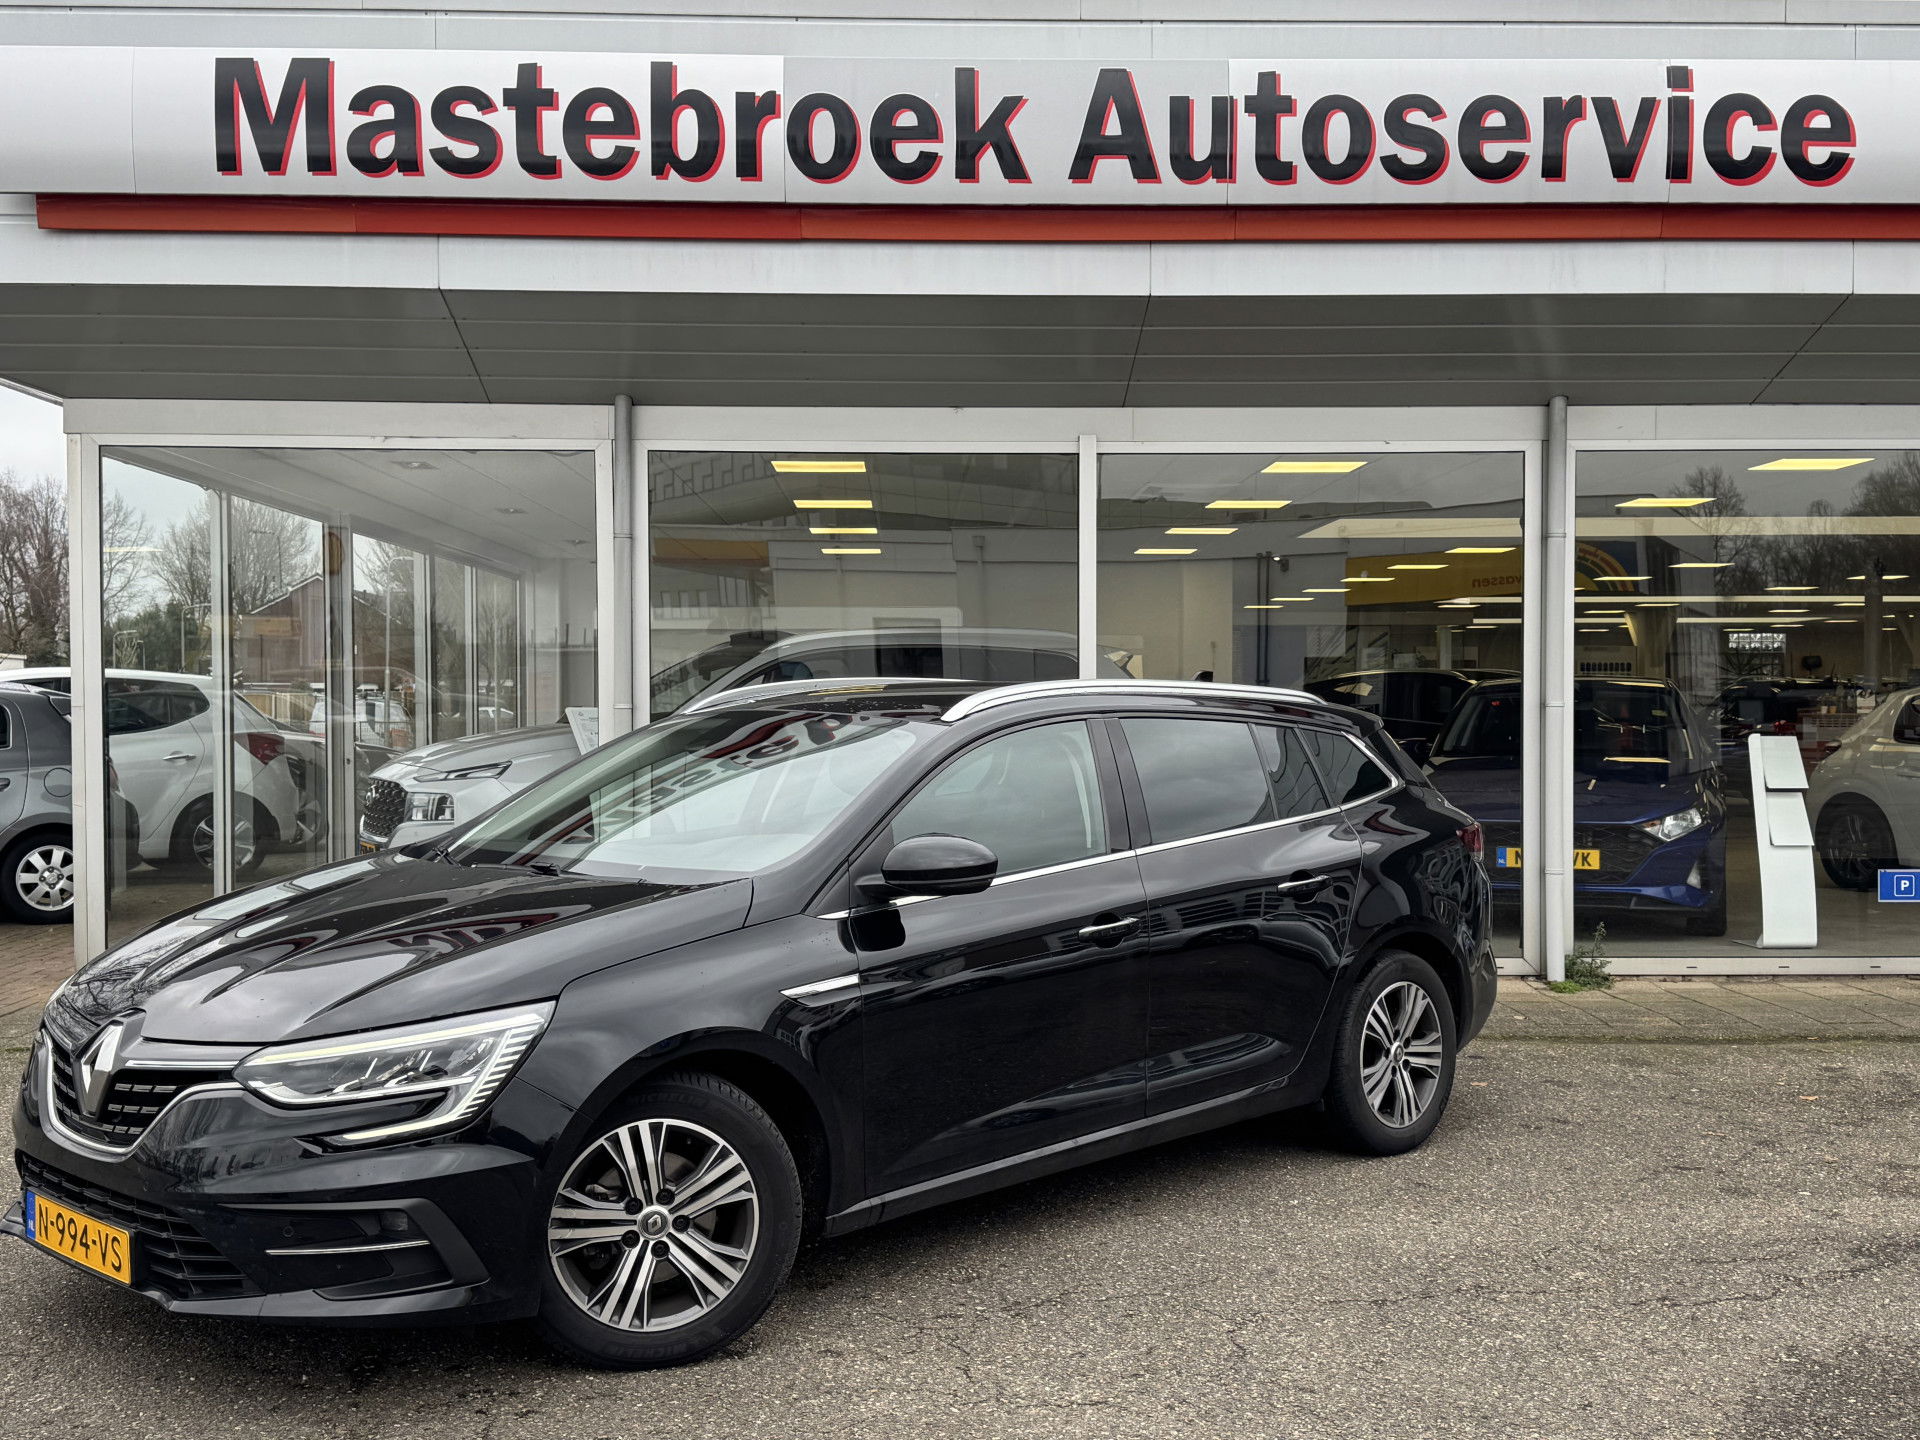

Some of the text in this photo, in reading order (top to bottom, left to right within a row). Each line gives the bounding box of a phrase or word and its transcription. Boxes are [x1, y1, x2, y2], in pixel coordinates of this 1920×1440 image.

[213, 58, 1857, 187] Mastebroek Autoservice
[1901, 880, 1910, 891] P
[28, 1218, 35, 1232] NL
[38, 1203, 122, 1273] N-994-VS
